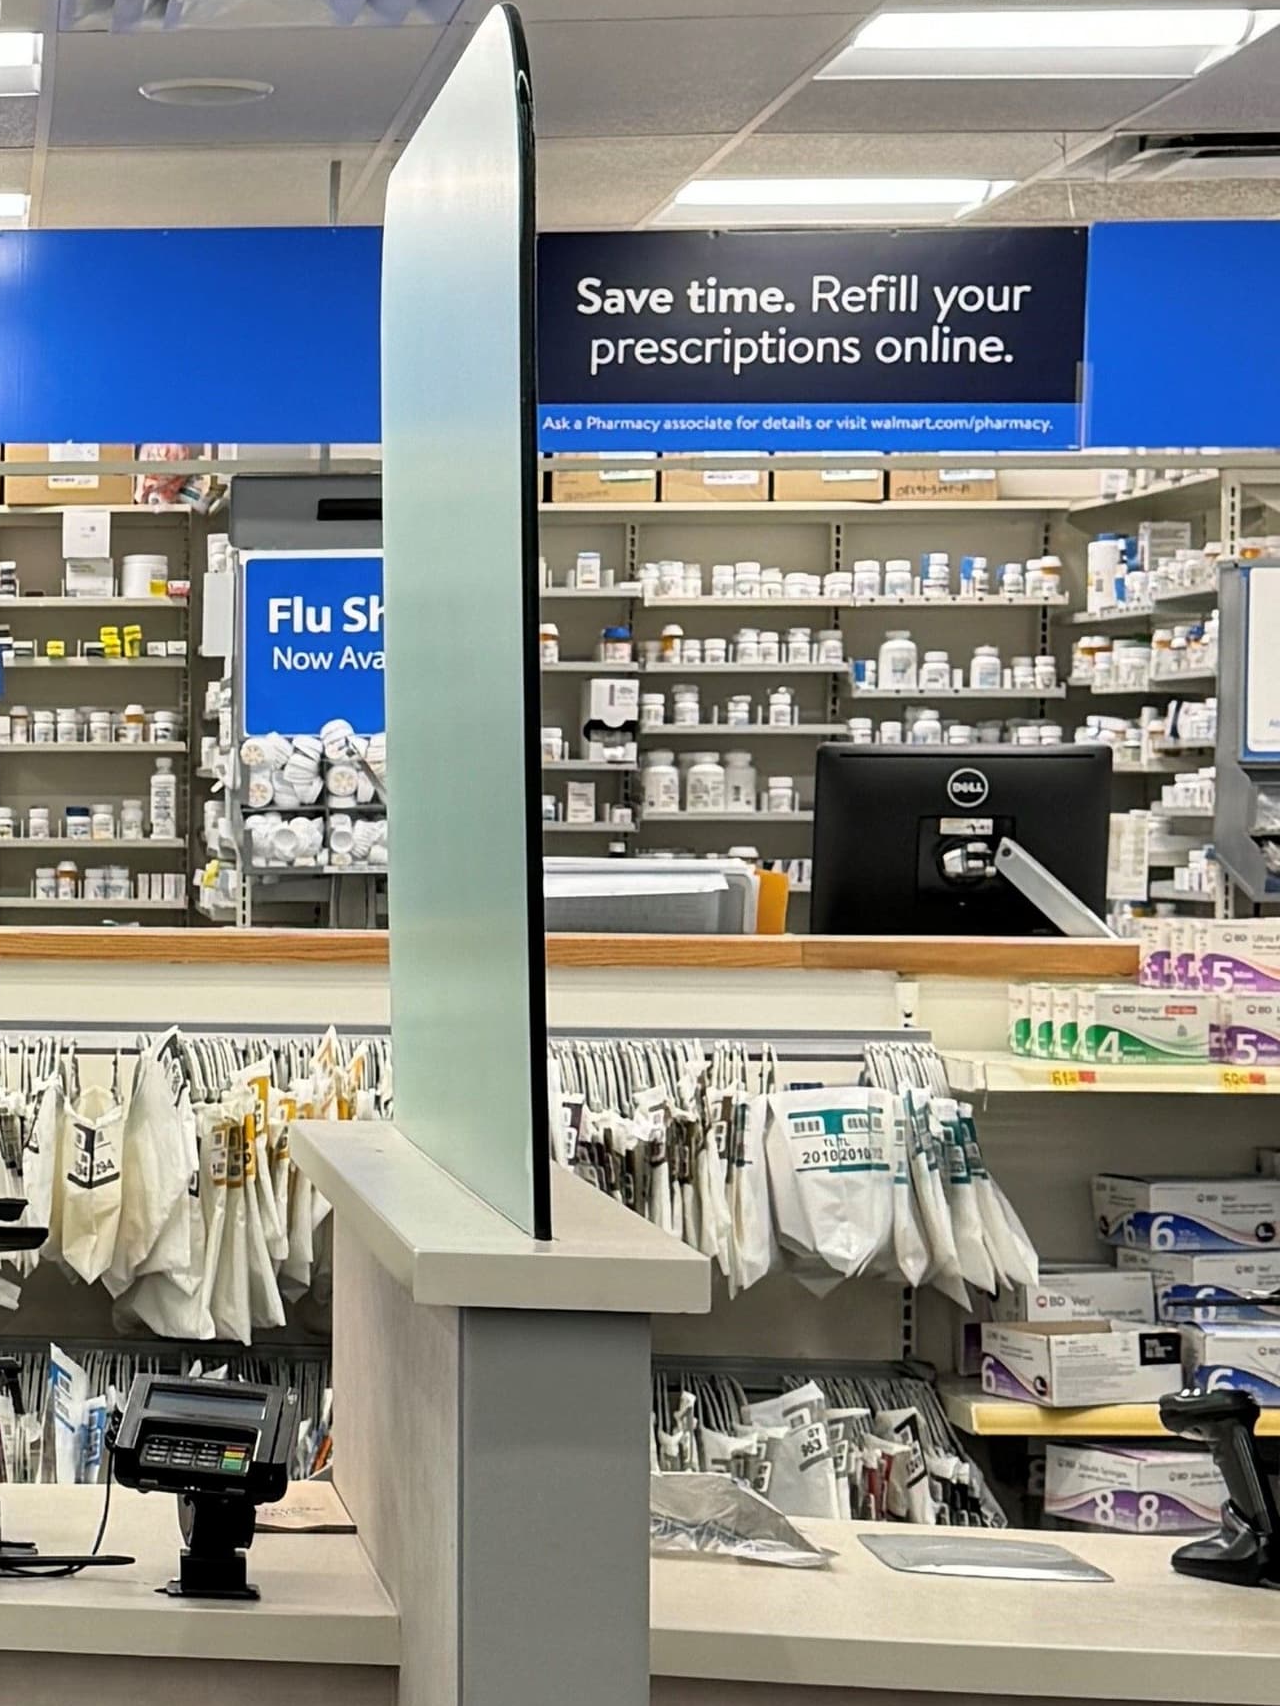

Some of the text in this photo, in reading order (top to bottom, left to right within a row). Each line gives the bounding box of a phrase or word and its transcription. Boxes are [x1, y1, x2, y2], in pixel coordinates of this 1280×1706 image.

[576, 274, 1032, 324] Save time. Refill your
[590, 325, 1014, 376] prescriptions online.
[542, 415, 1053, 433] Ask a Pharmacy associate for details or visit walmart.com/pharmacy.
[268, 595, 332, 634] Flu
[272, 645, 334, 671] Now
[952, 781, 984, 793] DELL
[1212, 961, 1235, 992] 5
[1097, 1031, 1123, 1063] 4
[1235, 1033, 1257, 1065] 5
[1150, 1215, 1176, 1251] 6
[1049, 1295, 1066, 1307] BD
[1094, 1491, 1116, 1524] 8
[1138, 1494, 1159, 1530] 8
